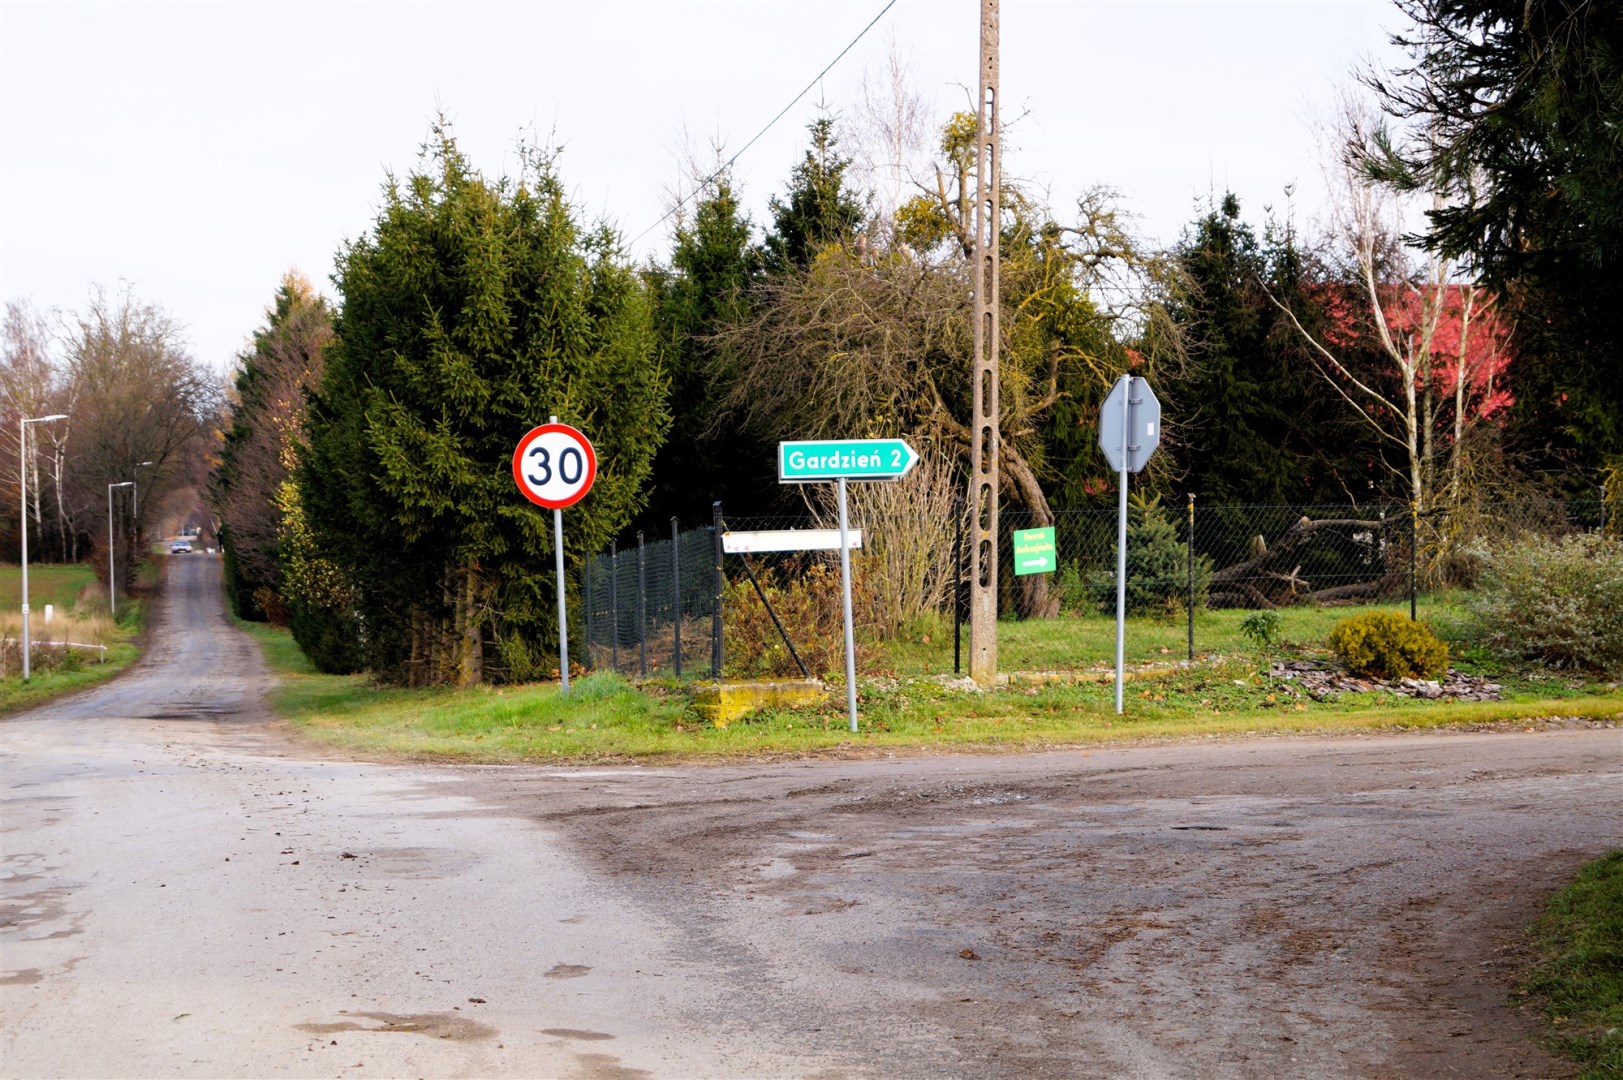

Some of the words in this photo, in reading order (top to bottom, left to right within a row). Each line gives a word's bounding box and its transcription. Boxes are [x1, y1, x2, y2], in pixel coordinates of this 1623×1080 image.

[527, 446, 583, 486] 30
[786, 447, 881, 470] Gardzień
[890, 446, 903, 467] 2
